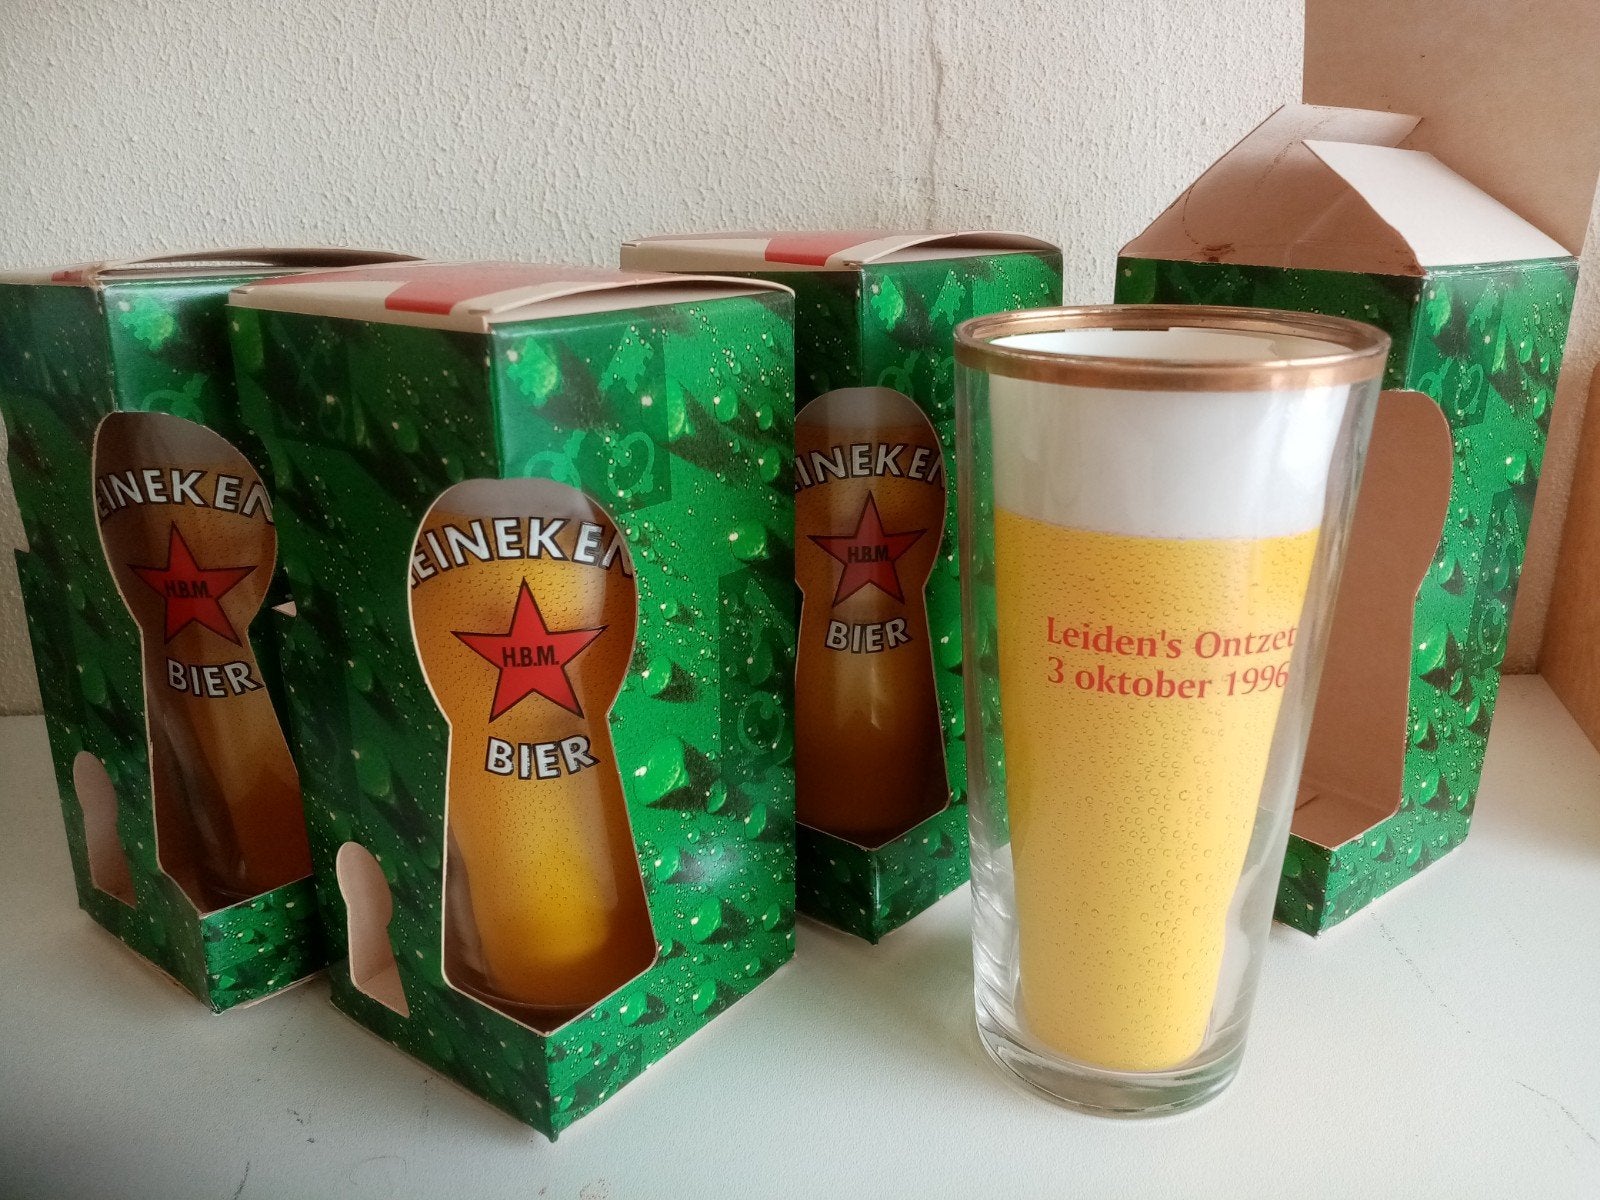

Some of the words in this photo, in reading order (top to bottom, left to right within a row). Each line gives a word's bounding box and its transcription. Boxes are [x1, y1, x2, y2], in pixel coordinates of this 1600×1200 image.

[795, 443, 945, 492] INEKE
[410, 516, 634, 590] EINEKEN
[501, 645, 560, 668] H.B.M.
[825, 618, 913, 654] BIER
[1047, 615, 1182, 659] Leiden's
[1194, 625, 1297, 659] Ontzet
[165, 656, 265, 698] BIER
[1047, 656, 1065, 684] 3
[1075, 664, 1212, 699] oktober
[1226, 660, 1291, 696] 1996
[485, 734, 600, 780] BIER
